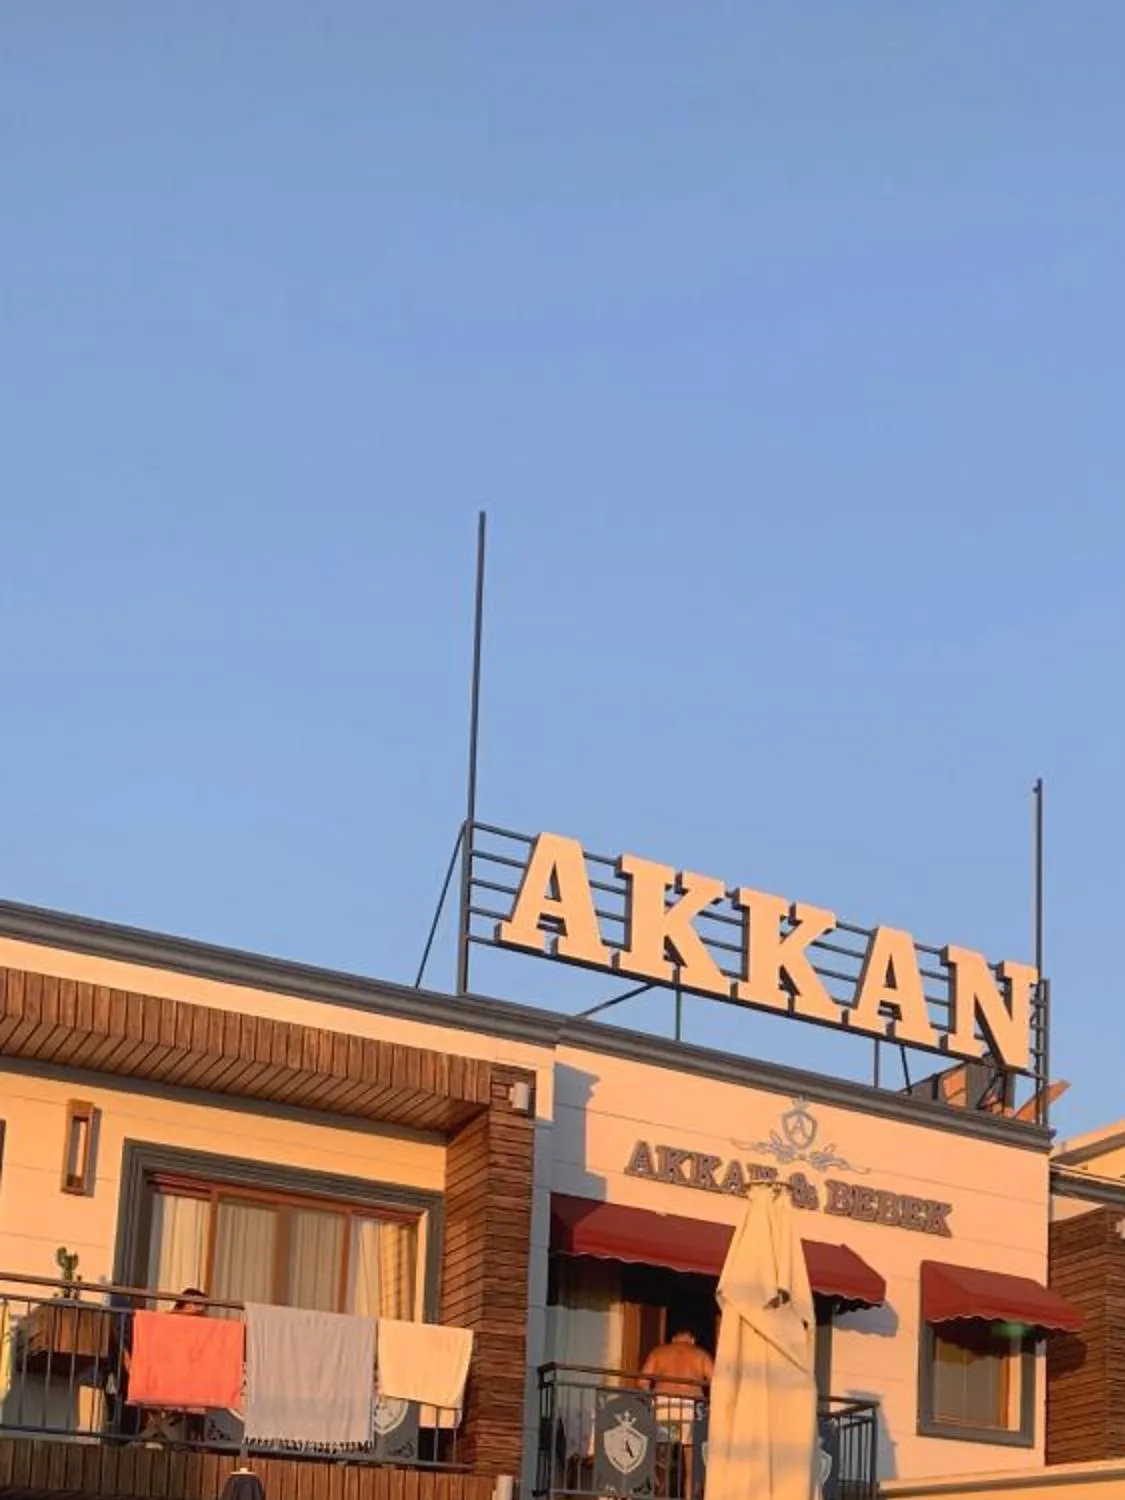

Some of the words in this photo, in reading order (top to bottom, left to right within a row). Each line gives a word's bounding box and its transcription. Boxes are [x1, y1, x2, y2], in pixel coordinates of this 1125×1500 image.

[495, 832, 1039, 1072] AKKAN
[789, 1172, 820, 1210] &
[823, 1179, 952, 1238] BEBEK
